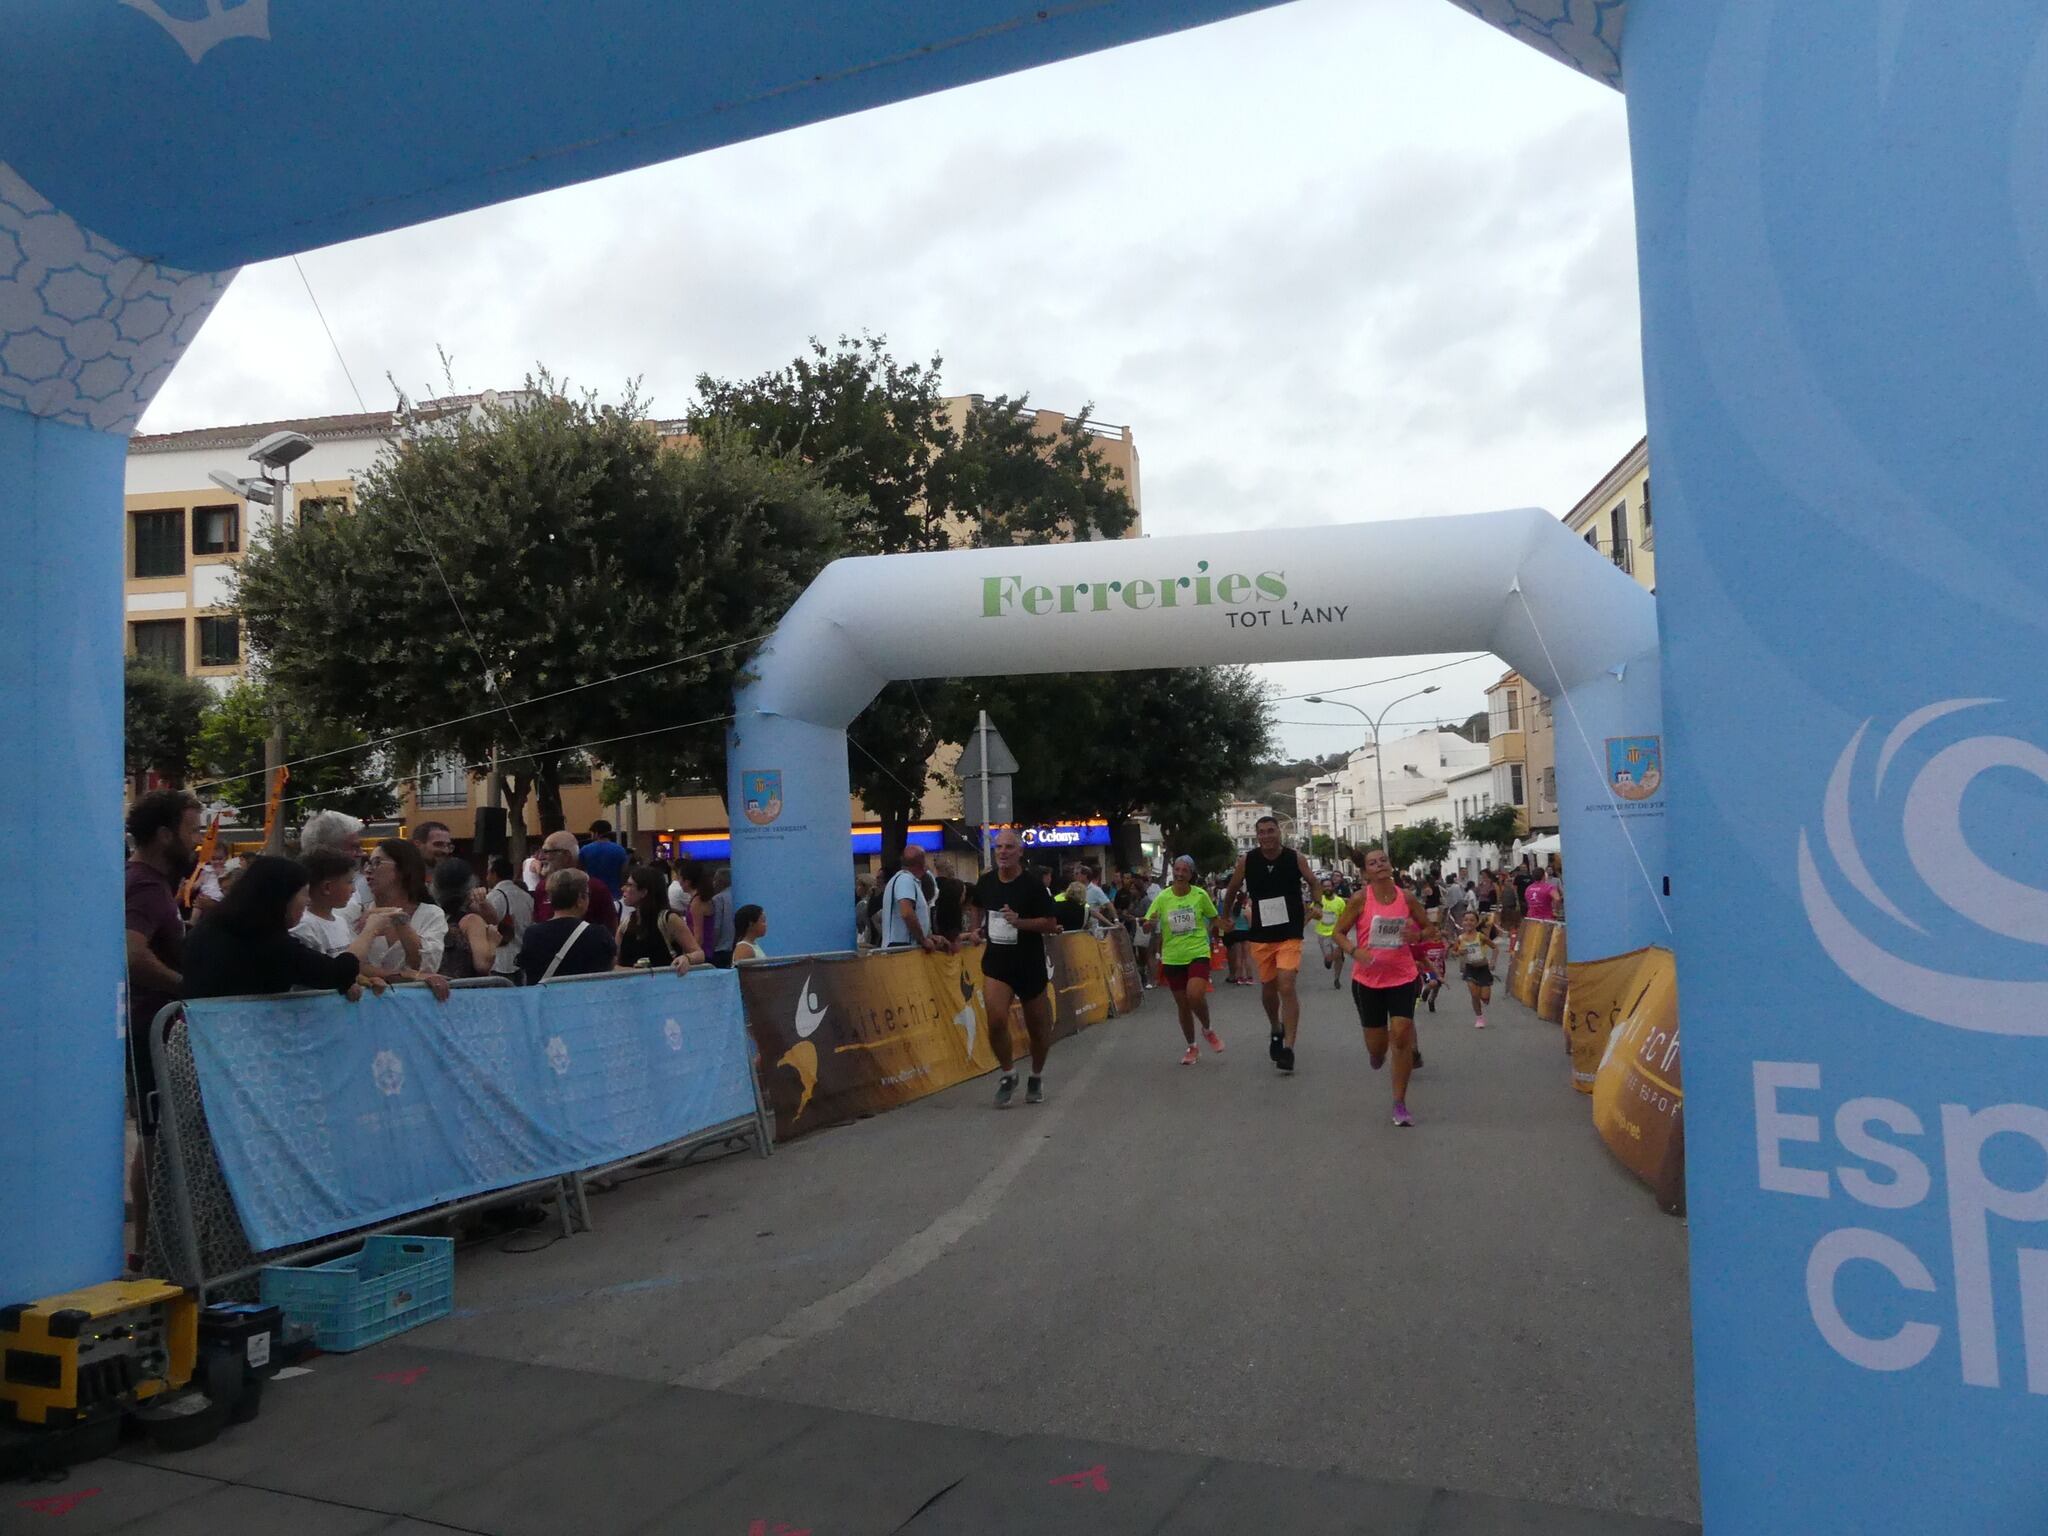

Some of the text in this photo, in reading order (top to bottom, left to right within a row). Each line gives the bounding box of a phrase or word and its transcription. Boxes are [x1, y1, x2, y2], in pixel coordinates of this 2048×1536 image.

[980, 560, 1288, 618] Ferreries
[1225, 601, 1350, 628] TOT L'ANY
